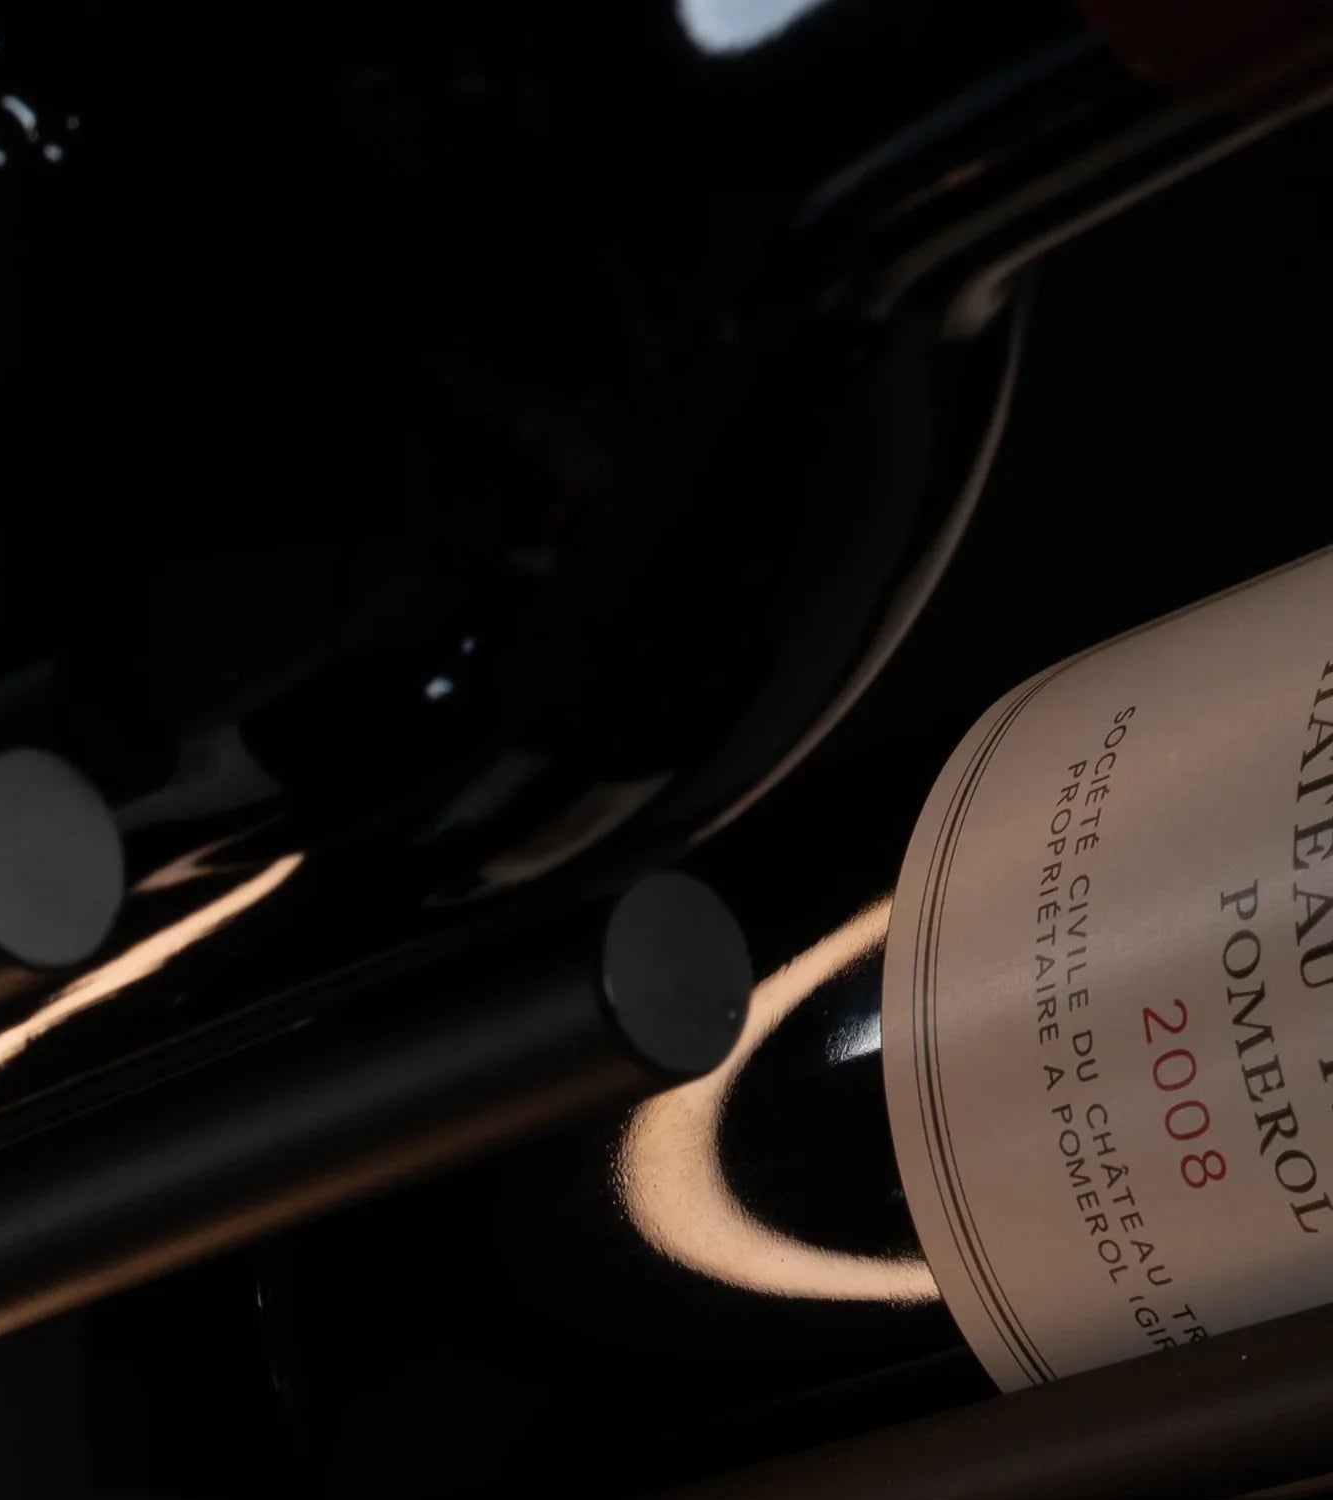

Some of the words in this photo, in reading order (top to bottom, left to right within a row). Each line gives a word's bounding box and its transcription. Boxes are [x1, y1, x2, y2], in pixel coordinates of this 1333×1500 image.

[1075, 705, 1136, 853] SOCIÉTÉ
[1036, 760, 1087, 1043] PROPRIÉTAIRE
[1066, 873, 1091, 1009] CIVILE
[1042, 1066, 1064, 1091] A
[1070, 1028, 1100, 1084] DU
[1143, 999, 1226, 1190] 2008
[1219, 878, 1333, 1236] POMEROL
[1051, 1104, 1128, 1286] POMEROL
[1085, 1102, 1174, 1288] CHÂTEAU
